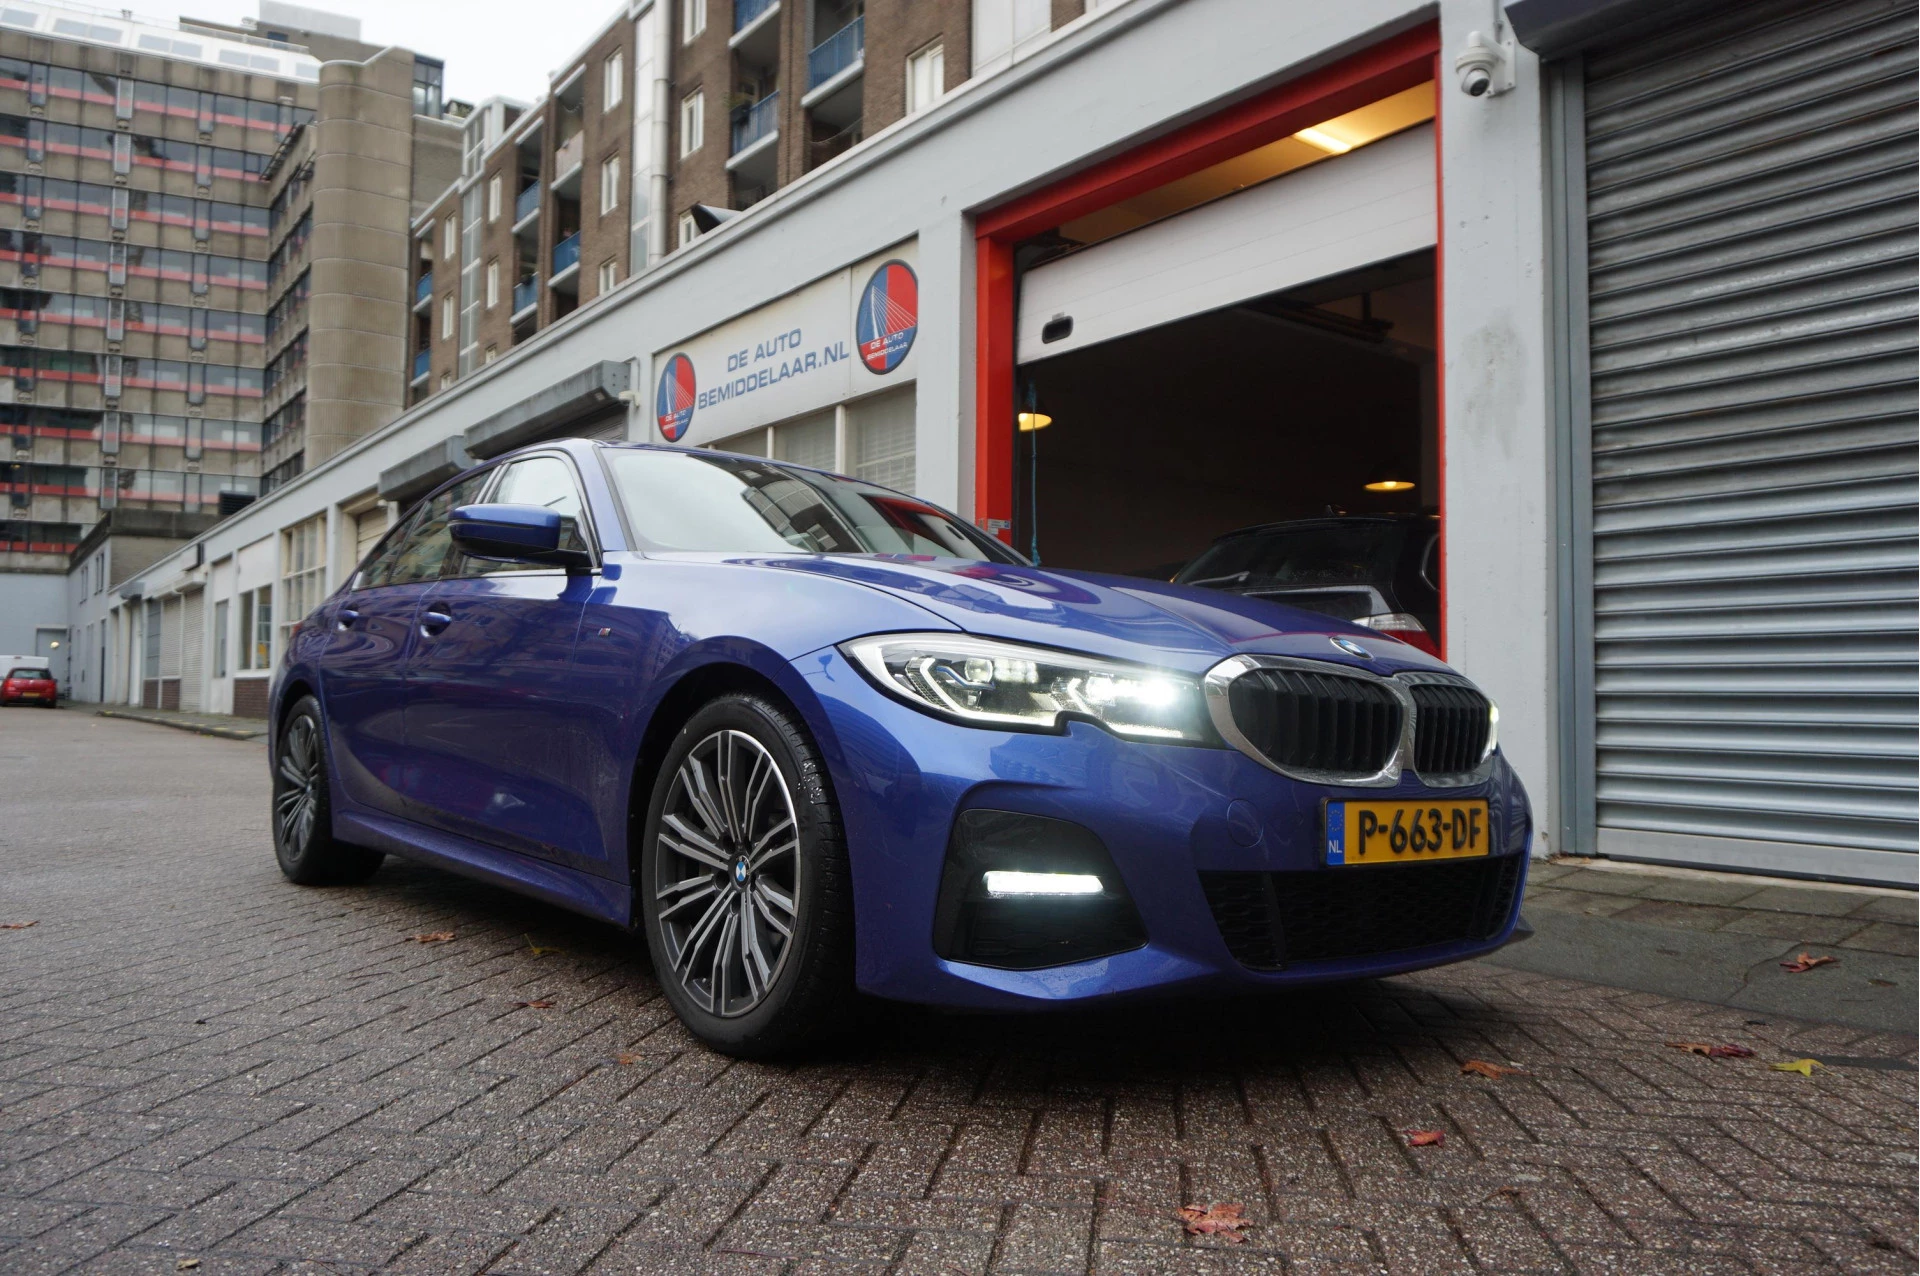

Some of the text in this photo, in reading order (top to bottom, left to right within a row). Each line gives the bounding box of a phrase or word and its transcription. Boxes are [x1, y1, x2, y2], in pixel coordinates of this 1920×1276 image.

[727, 328, 801, 373] DE AUTO
[870, 331, 904, 350] DE AUTO
[698, 341, 850, 410] BEMIDDELAAR.NL
[1328, 840, 1343, 853] NL
[1358, 807, 1482, 856] P-663-DF
